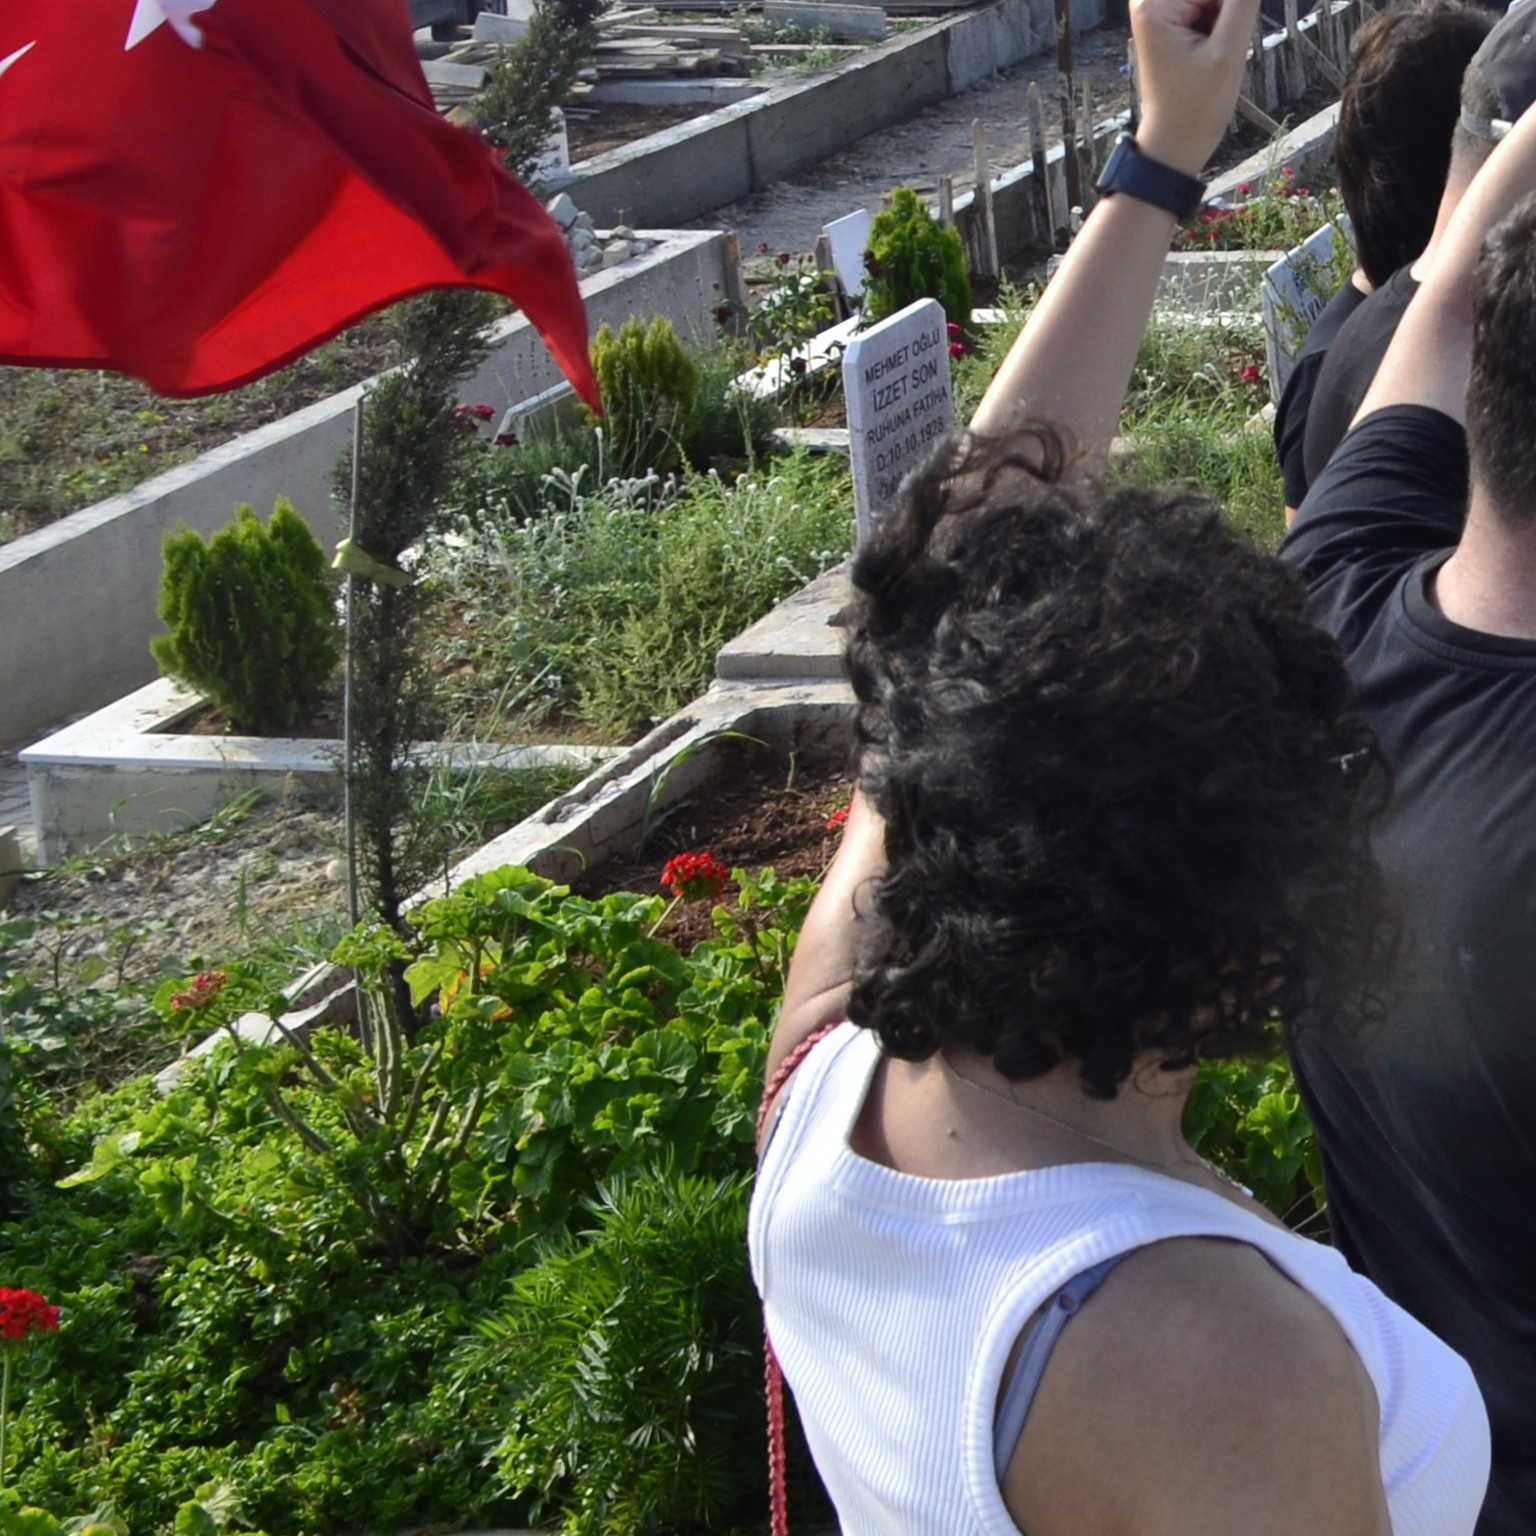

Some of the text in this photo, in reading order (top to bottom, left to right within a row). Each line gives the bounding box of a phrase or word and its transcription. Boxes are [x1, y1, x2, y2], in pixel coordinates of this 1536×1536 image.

[865, 328, 940, 384] MEHMET OĞLU
[872, 358, 938, 413] İZZET SON
[867, 408, 912, 447] RUHUNA
